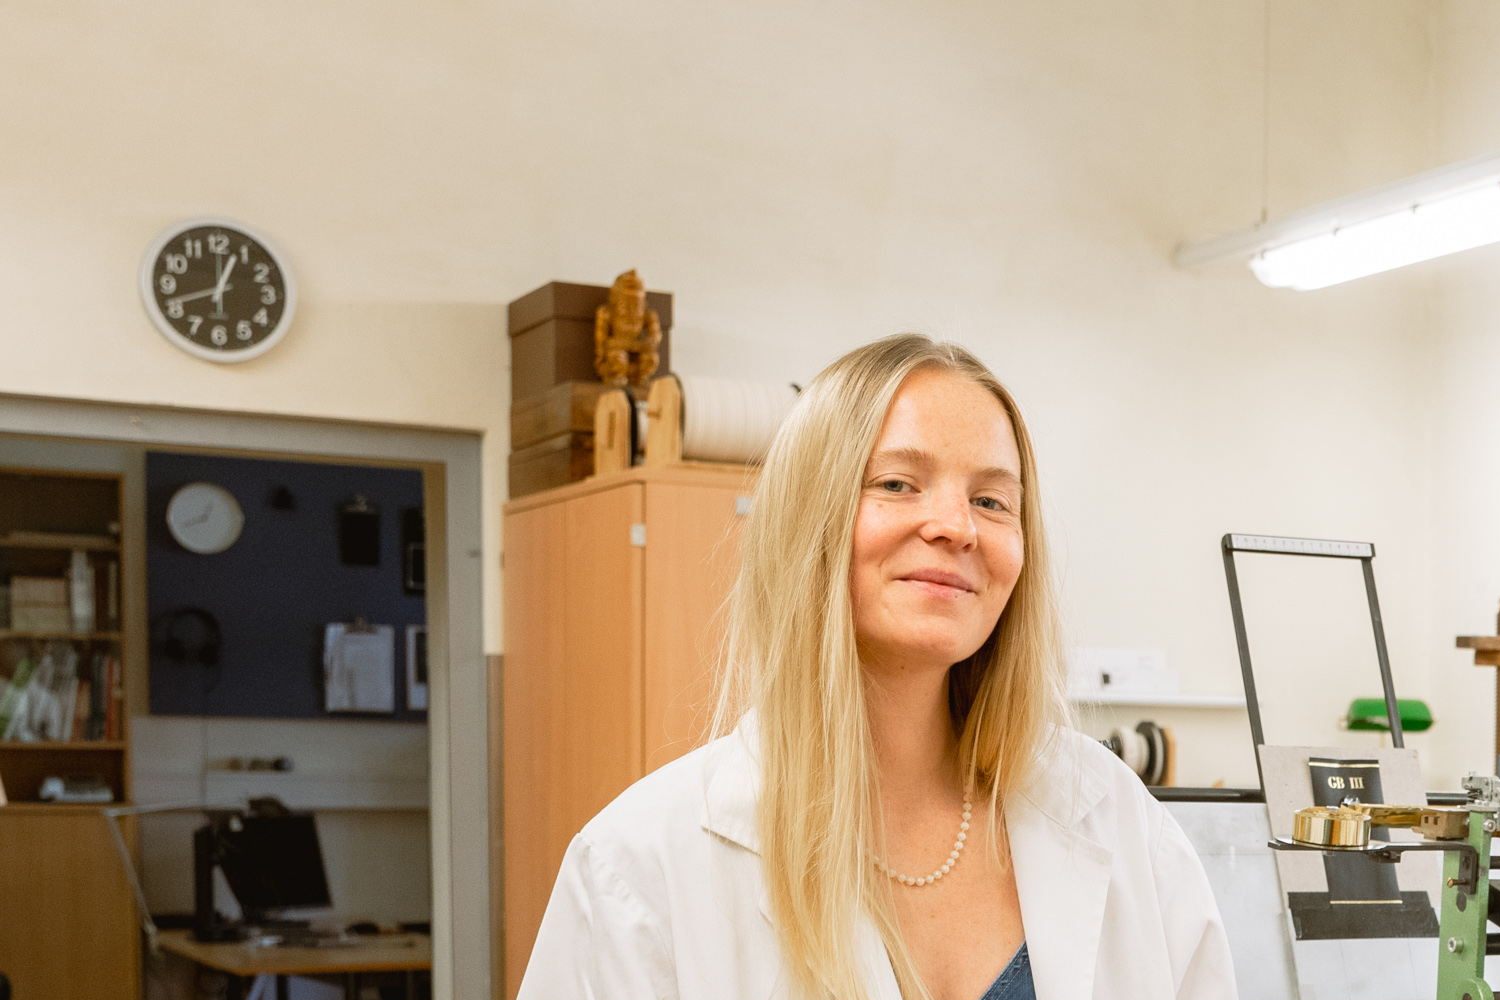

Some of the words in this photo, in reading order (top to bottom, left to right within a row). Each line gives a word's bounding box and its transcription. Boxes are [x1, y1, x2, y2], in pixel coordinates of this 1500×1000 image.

[184, 238, 202, 260] 11
[208, 233, 230, 255] 12
[240, 245, 249, 264] 1
[166, 253, 188, 275] 10
[253, 263, 270, 284] 2
[159, 274, 177, 295] 9
[260, 284, 277, 305] 3
[168, 299, 185, 319] 8
[253, 307, 269, 327] 4
[187, 315, 204, 336] 7
[210, 325, 228, 346] 6
[236, 320, 253, 341] 5
[1348, 776, 1365, 790] III
